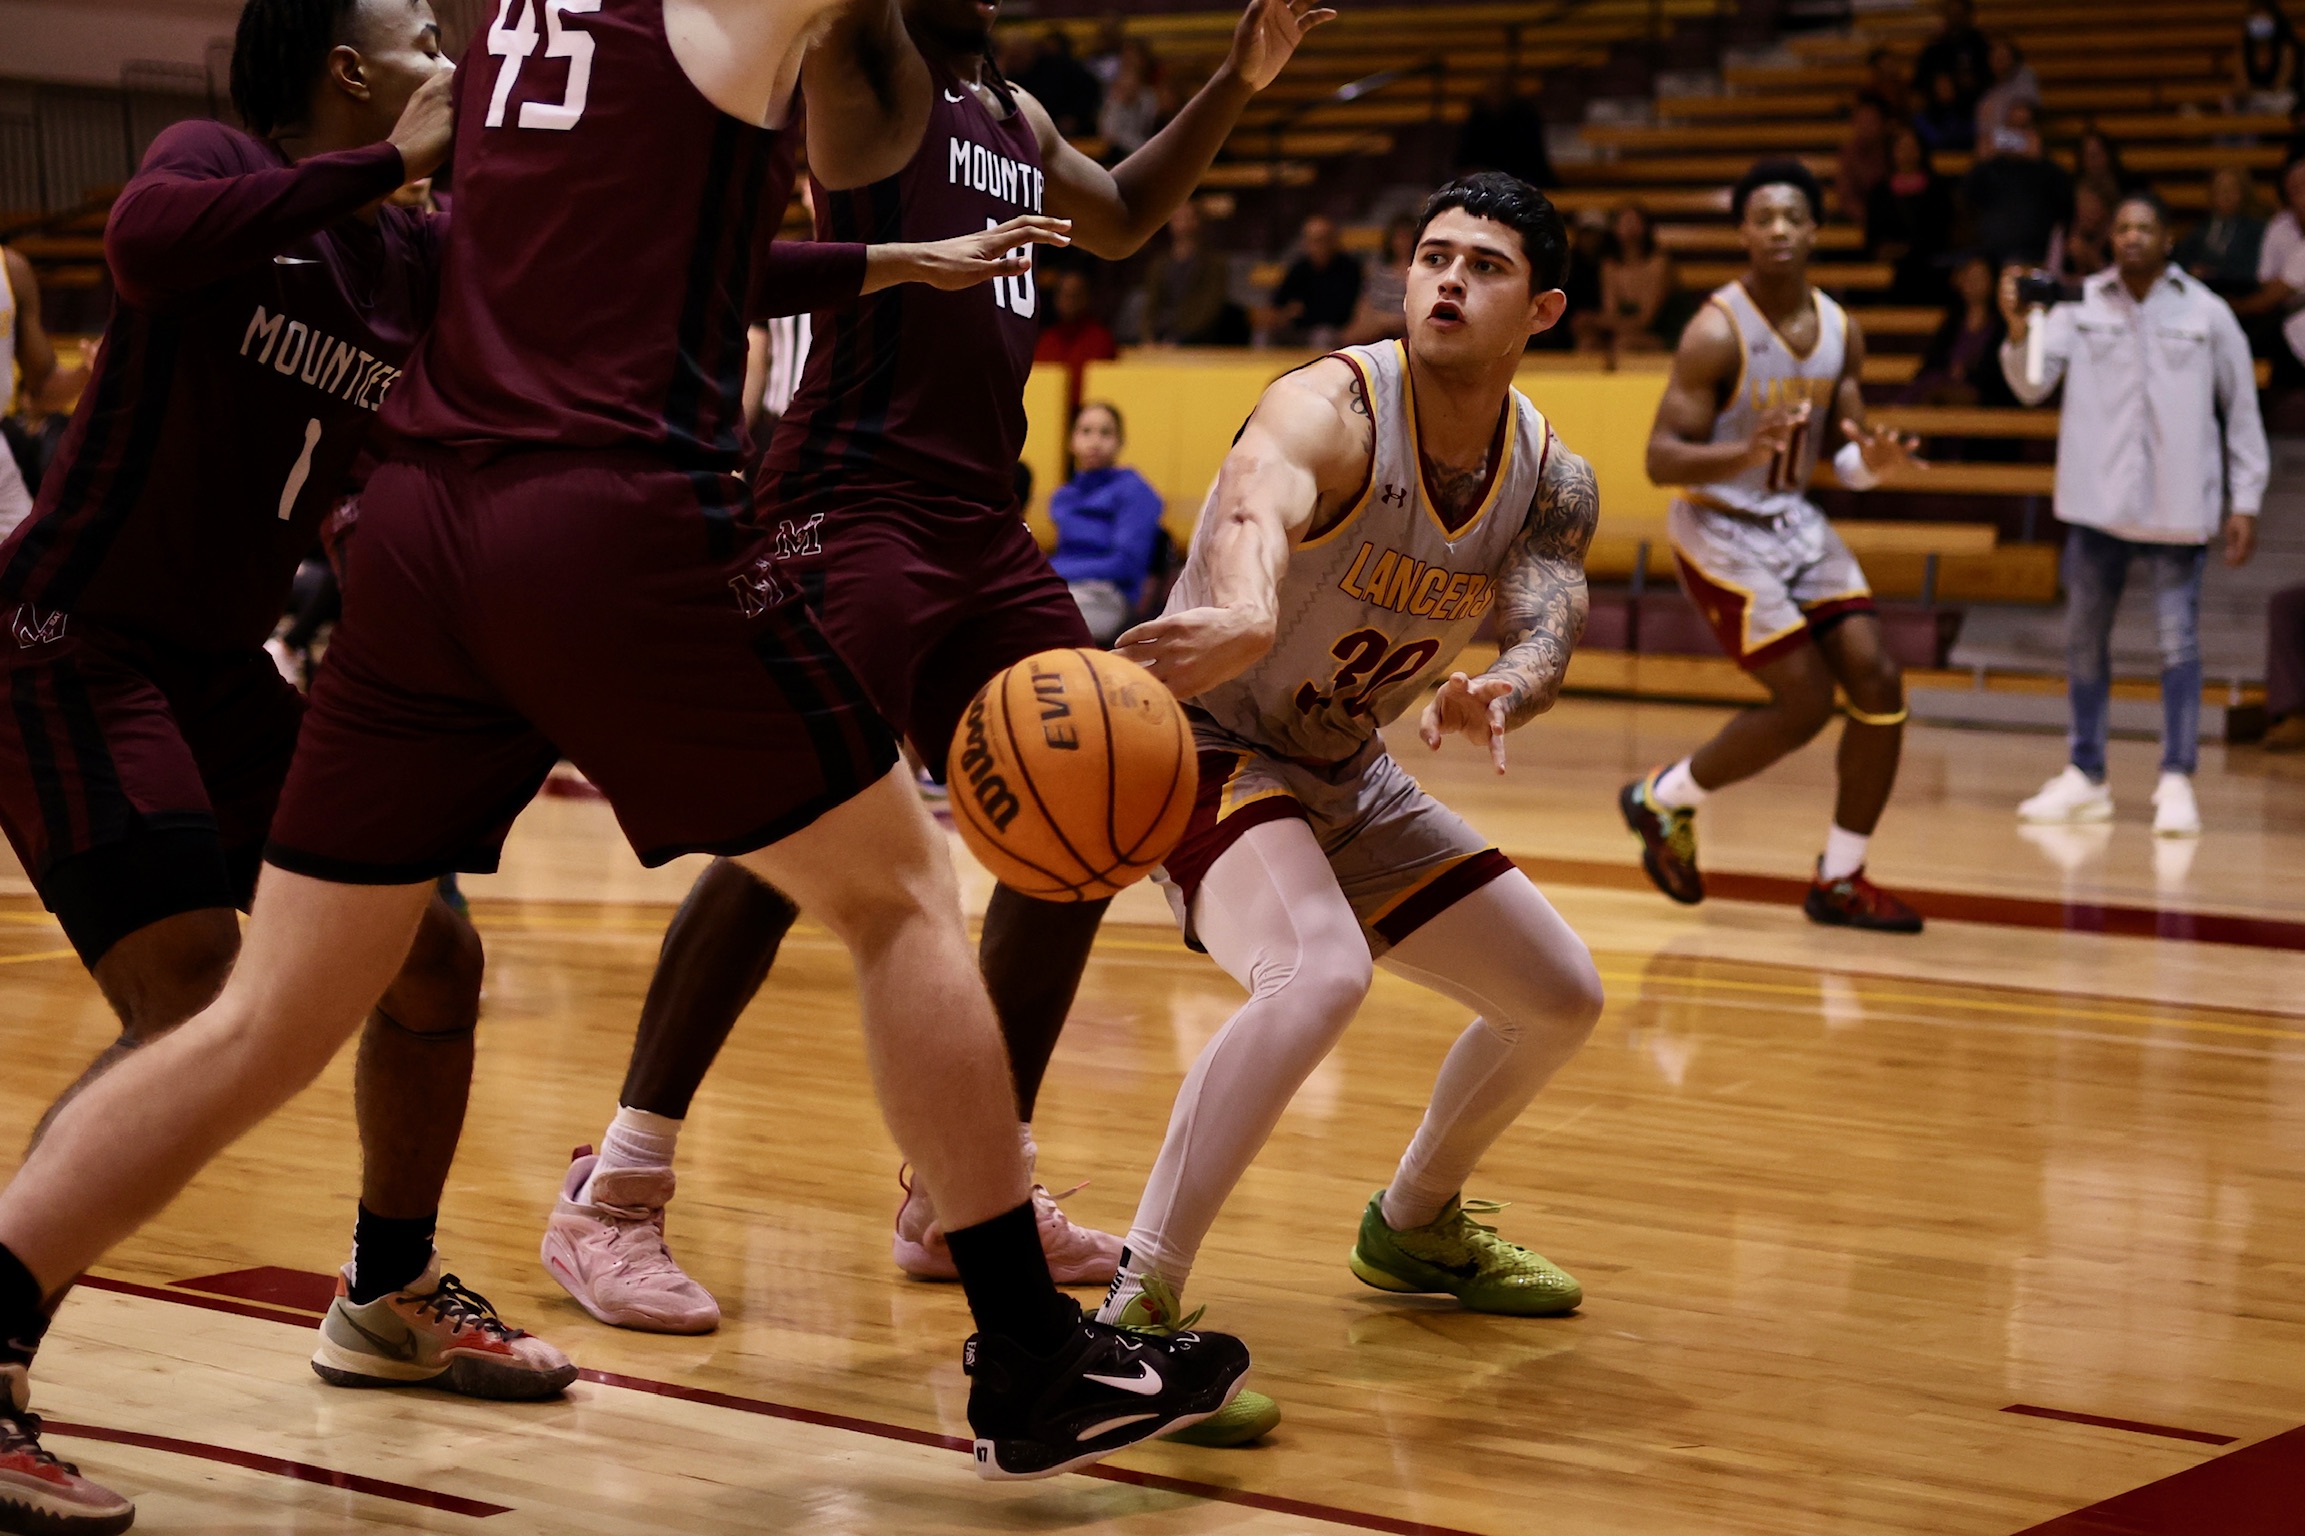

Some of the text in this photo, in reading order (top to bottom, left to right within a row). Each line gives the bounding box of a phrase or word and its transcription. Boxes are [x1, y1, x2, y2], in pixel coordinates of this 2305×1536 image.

[485, 0, 601, 130] 45
[240, 304, 402, 411] MOUNTIES
[277, 417, 322, 520] 1
[1338, 541, 1497, 621] LANCERS
[1293, 626, 1442, 718] 30
